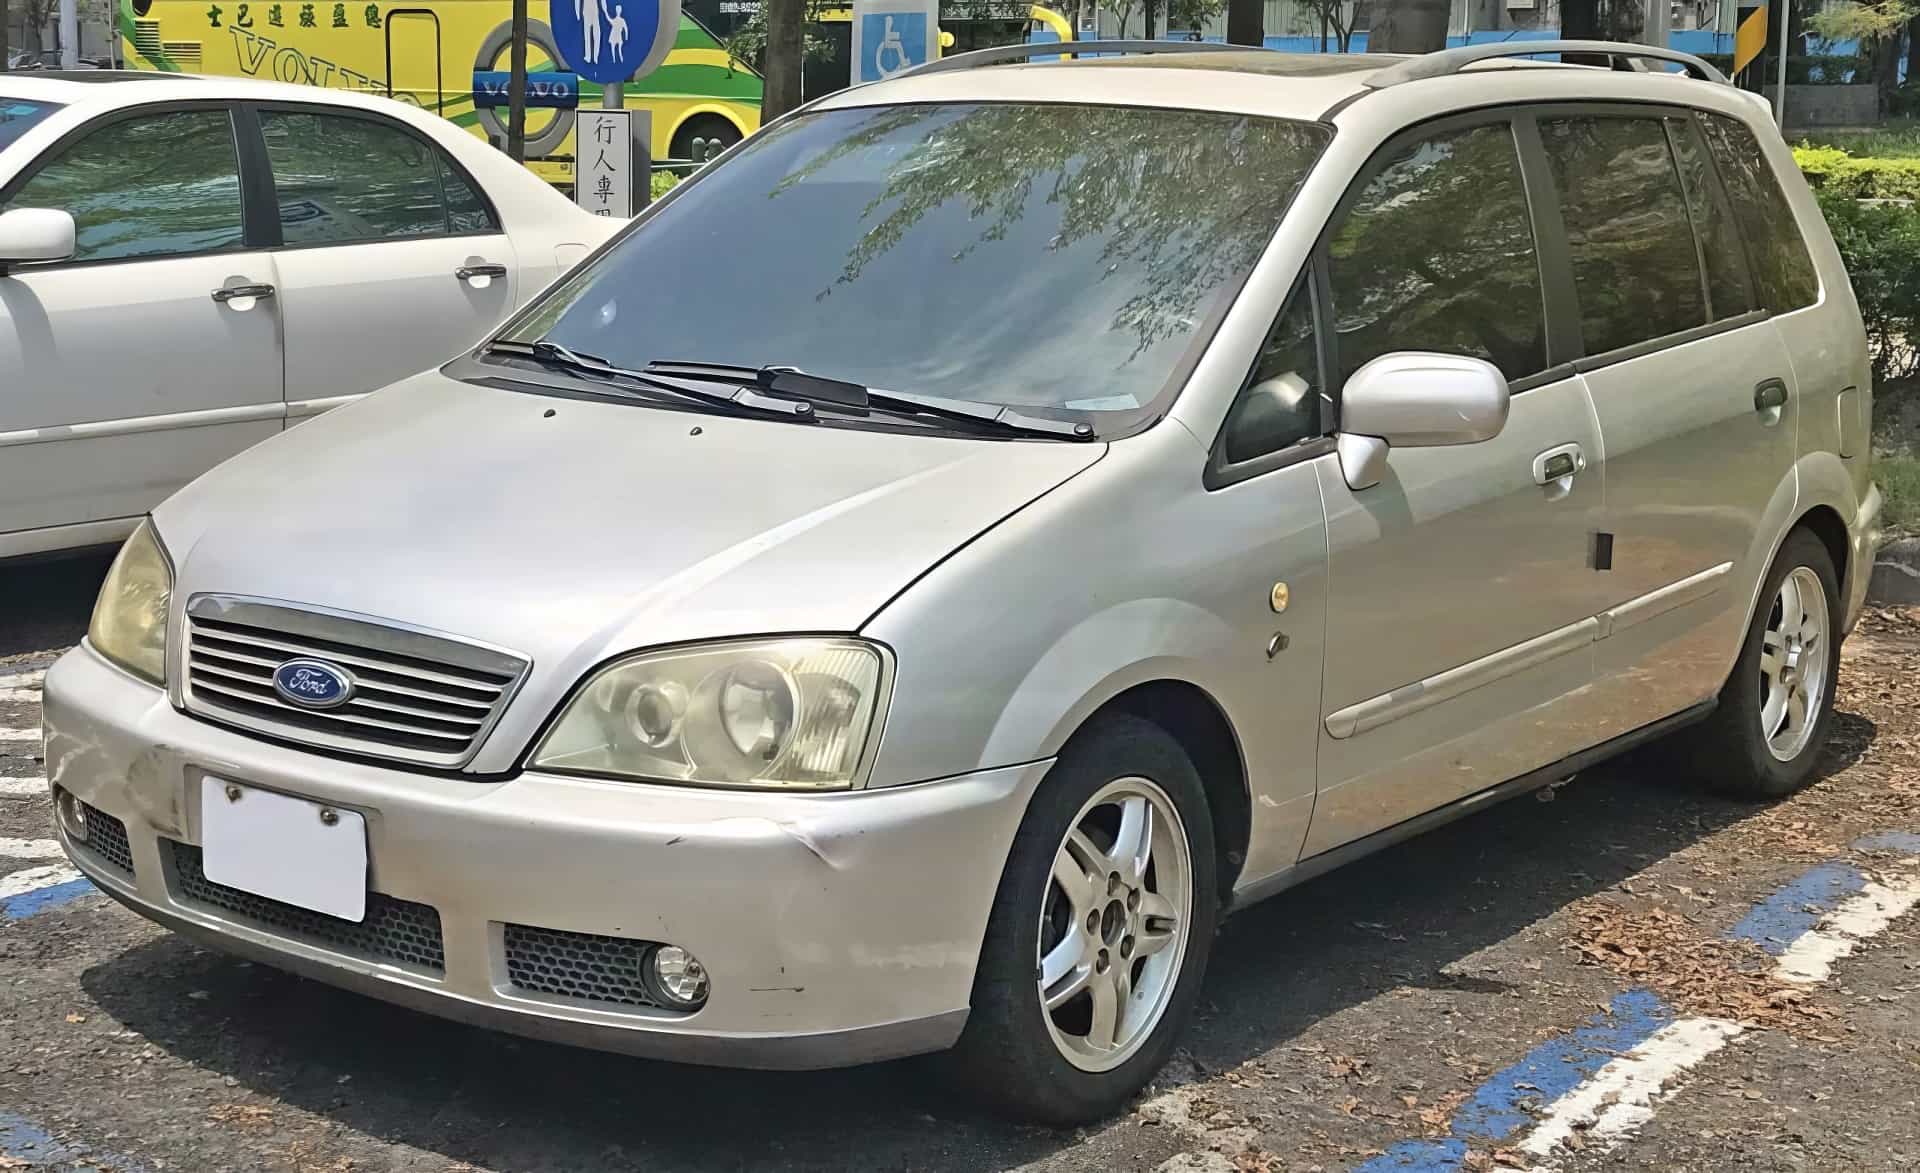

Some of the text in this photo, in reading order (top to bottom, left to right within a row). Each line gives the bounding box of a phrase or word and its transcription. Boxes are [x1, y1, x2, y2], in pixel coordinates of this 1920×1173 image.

[229, 25, 424, 109] VOL
[482, 80, 569, 98] VOVO
[592, 115, 617, 217] 行人專
[289, 669, 331, 695] Ford
